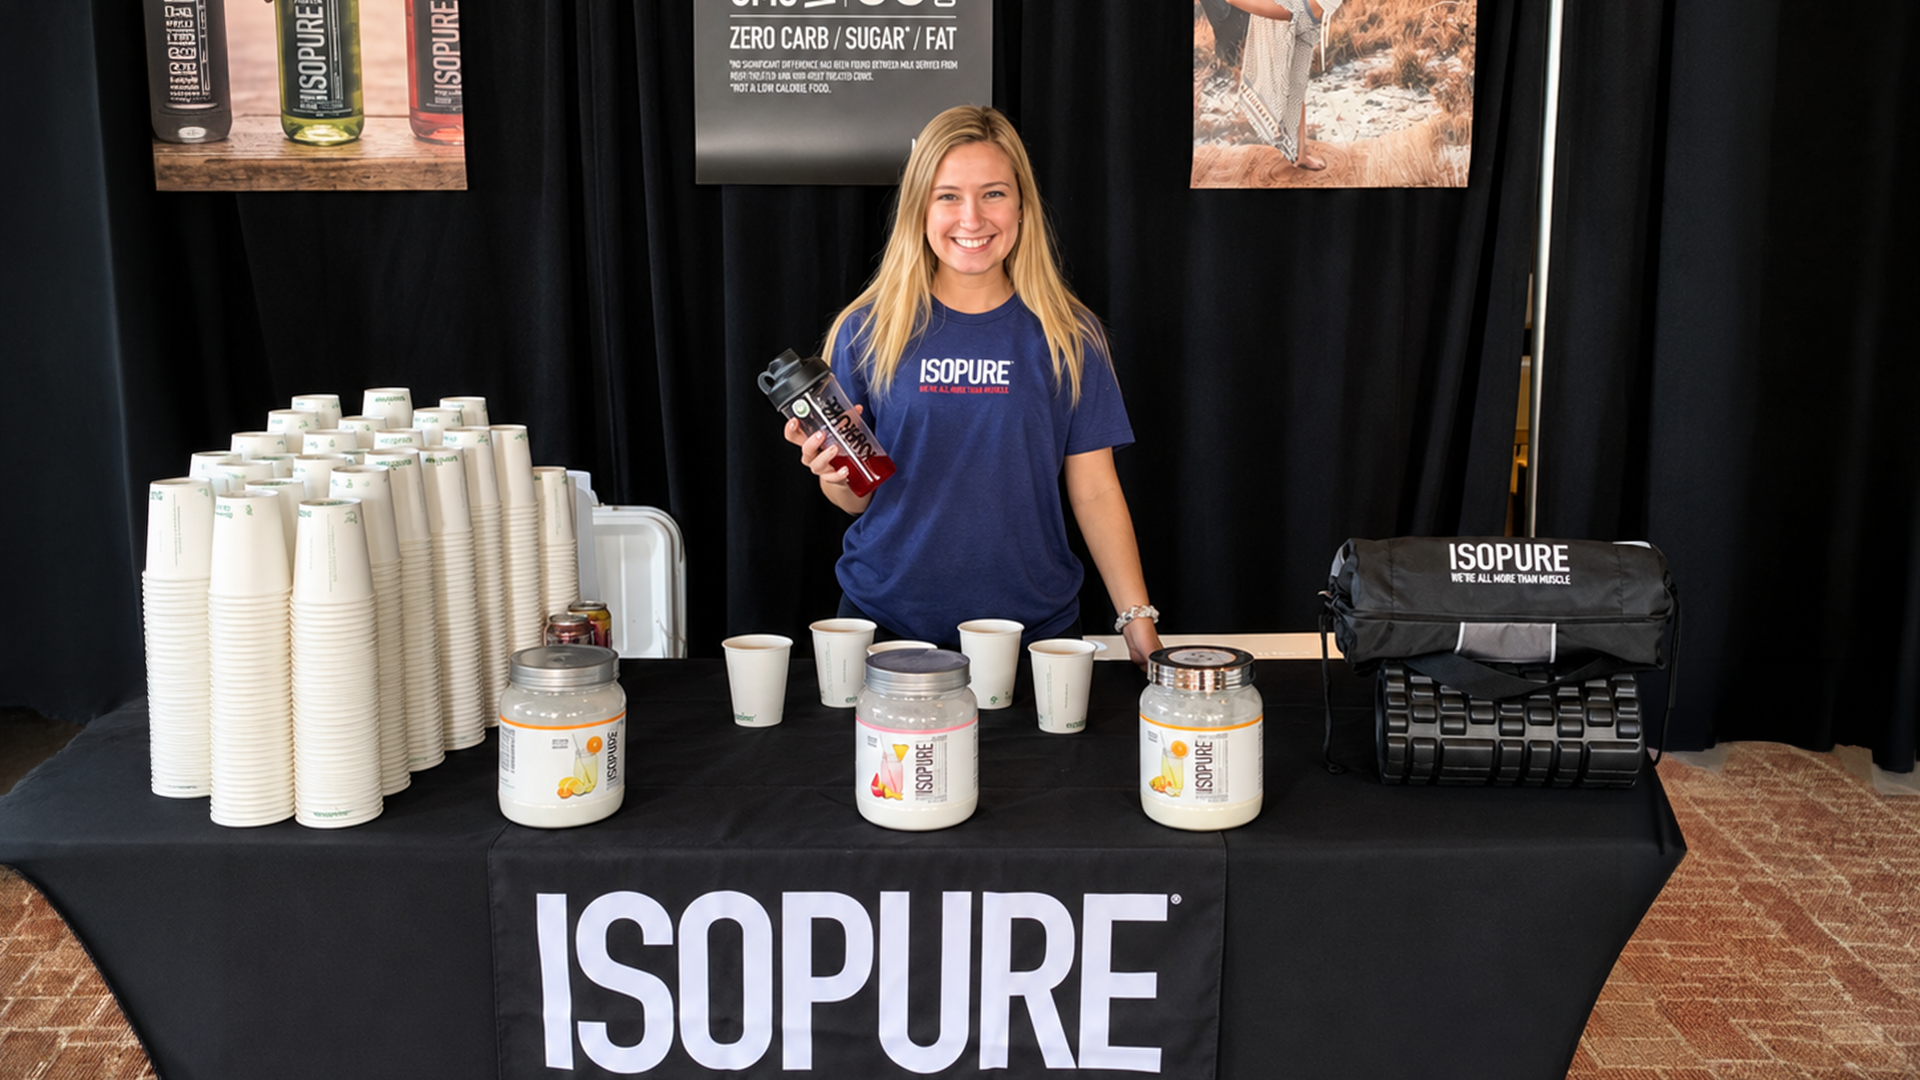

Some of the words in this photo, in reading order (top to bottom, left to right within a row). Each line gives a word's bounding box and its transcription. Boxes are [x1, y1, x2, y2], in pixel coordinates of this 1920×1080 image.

[295, 5, 328, 94] ISOPURE
[430, 0, 462, 89] ISOPURE
[729, 25, 776, 50] ZERO
[781, 25, 829, 50] CARB
[926, 26, 958, 50] FAT
[919, 358, 1011, 385] ISOPURE
[1448, 543, 1570, 572] ISOPURE
[1477, 573, 1493, 584] ALL
[1493, 573, 1517, 584] MORE
[1517, 574, 1538, 584] THAN
[1539, 574, 1572, 585] MUSCLE
[915, 742, 934, 795] ISOPURE
[1194, 739, 1213, 794] ISOPURE
[535, 890, 1170, 1075] ISOPURE
